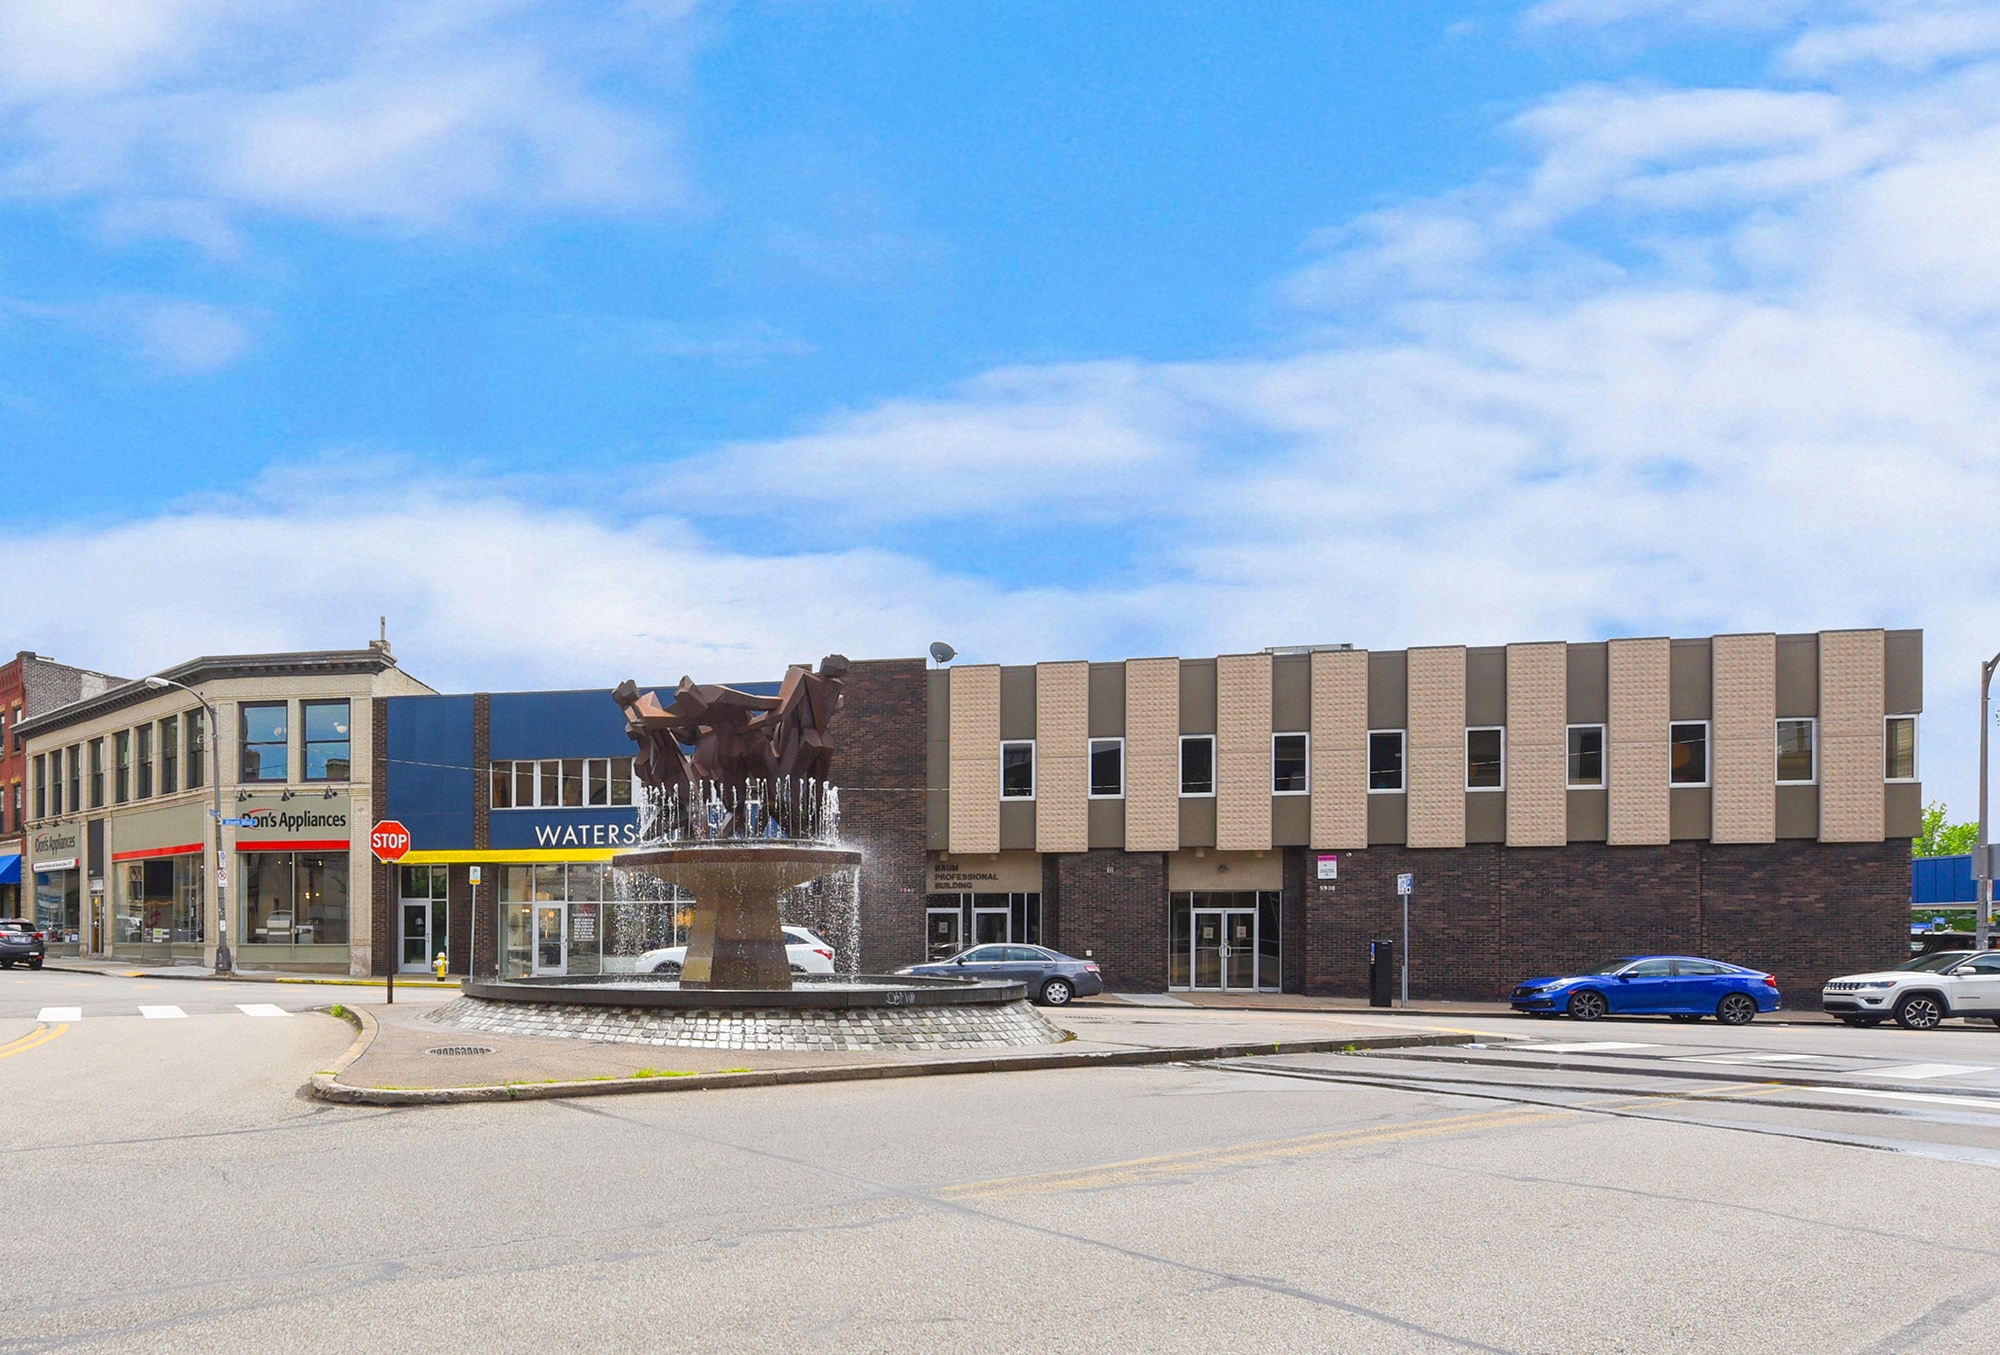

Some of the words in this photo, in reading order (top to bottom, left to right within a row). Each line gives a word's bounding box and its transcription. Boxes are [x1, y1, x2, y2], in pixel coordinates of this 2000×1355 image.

[279, 810, 347, 832] Appliances
[35, 837, 49, 852] Don's
[49, 833, 76, 855] Appliances
[372, 833, 407, 849] STOP
[934, 873, 999, 881] PROFESSIONAL
[934, 882, 973, 890] BUILDING
